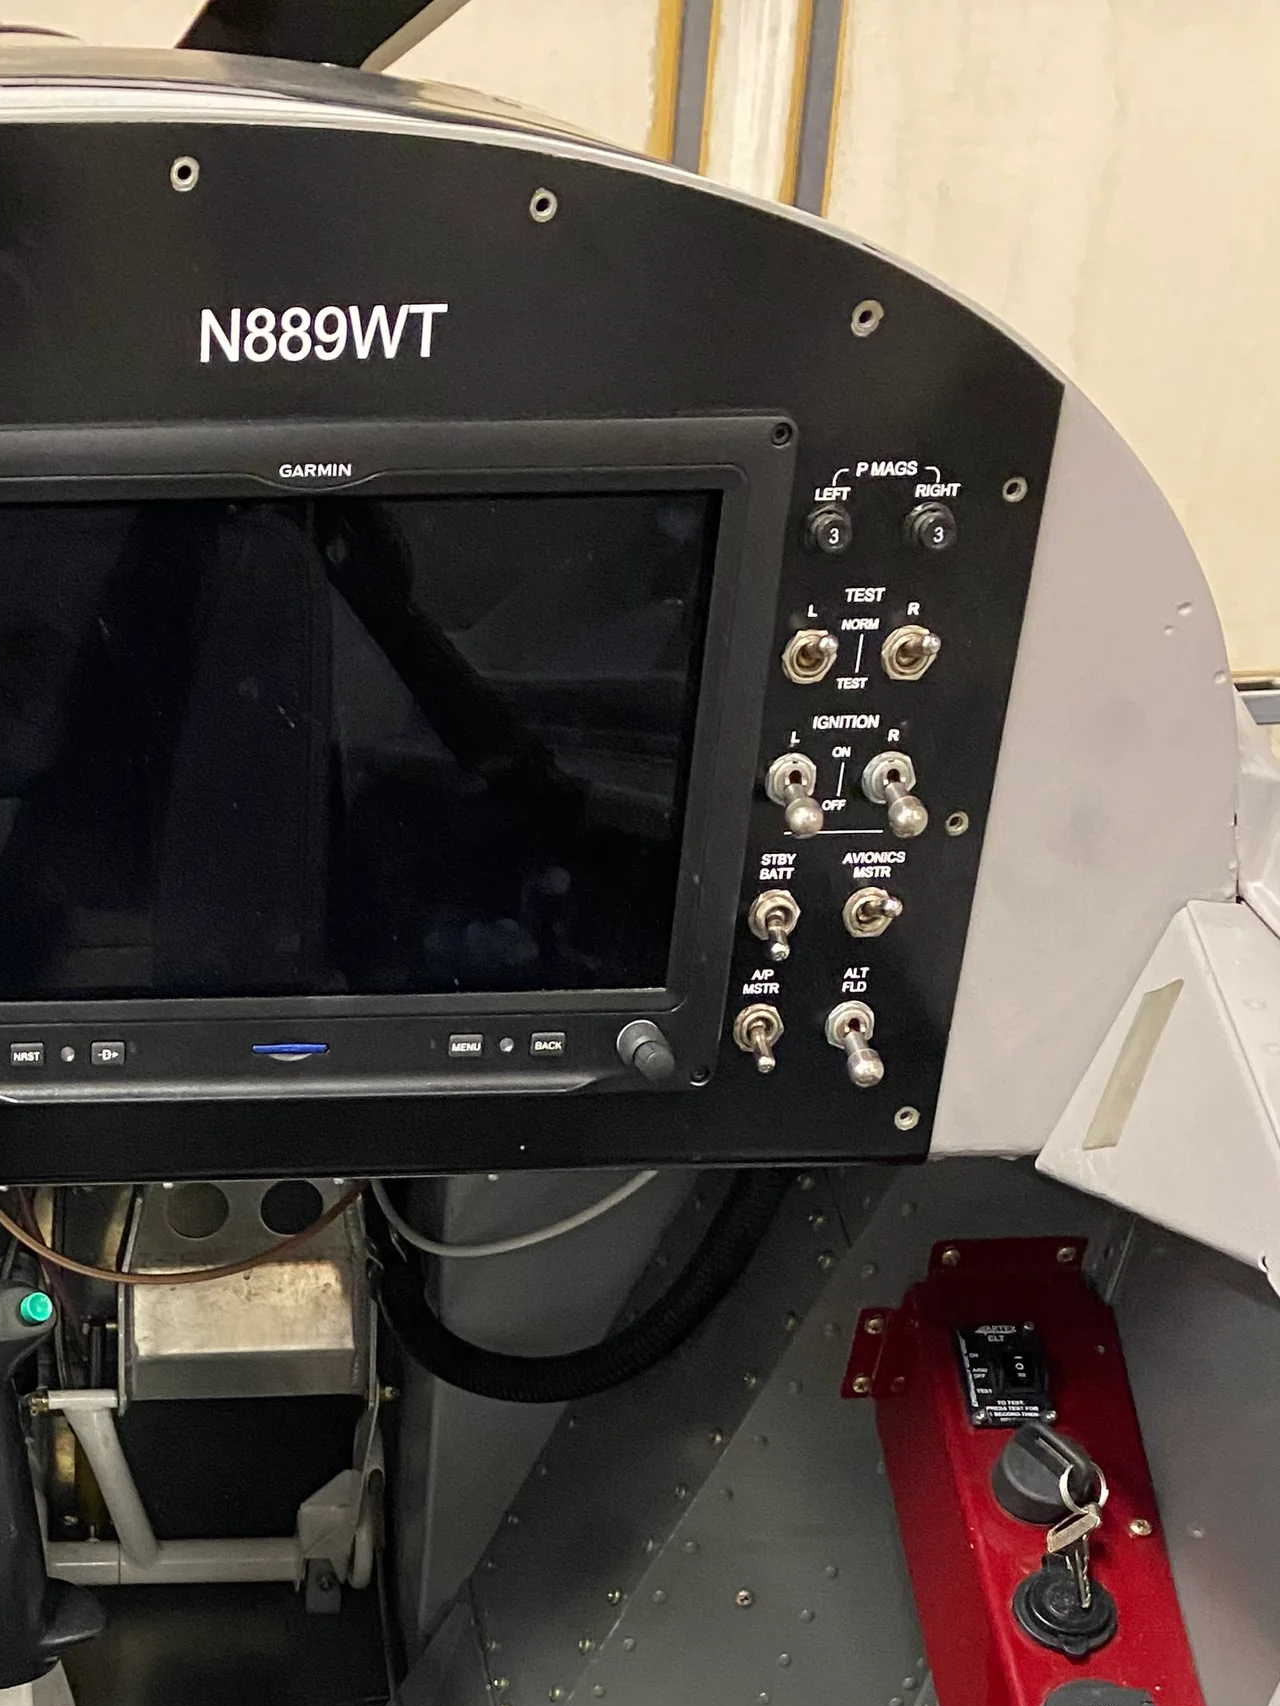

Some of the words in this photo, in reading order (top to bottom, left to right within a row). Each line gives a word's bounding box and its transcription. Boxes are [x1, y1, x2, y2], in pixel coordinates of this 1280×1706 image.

[200, 304, 448, 362] N889WT
[279, 464, 351, 477] GARMIN
[856, 462, 869, 477] P
[871, 461, 918, 476] MAGS
[815, 487, 851, 501] LEFT
[915, 483, 961, 497] RIGHT
[829, 528, 838, 544] 3
[934, 527, 943, 542] 3
[845, 588, 886, 602] TEST
[808, 605, 817, 617] L
[908, 602, 919, 615] R
[841, 618, 879, 630] NORM
[836, 678, 868, 689] TEST
[813, 715, 880, 729] IGNITION
[790, 731, 800, 744] L
[888, 729, 899, 741] R
[832, 747, 851, 757] ON
[822, 799, 846, 810] OFF
[761, 854, 796, 865] STBY
[842, 851, 905, 864] AVIONICS
[760, 867, 794, 880] BATT
[853, 866, 891, 878] MSTR
[751, 969, 774, 980] A/P
[844, 967, 869, 979] ALT
[743, 983, 779, 994] MSTR
[842, 981, 866, 992] FLD
[452, 1043, 481, 1051] MENU
[535, 1041, 561, 1050] BACK
[14, 1052, 40, 1061] NRST
